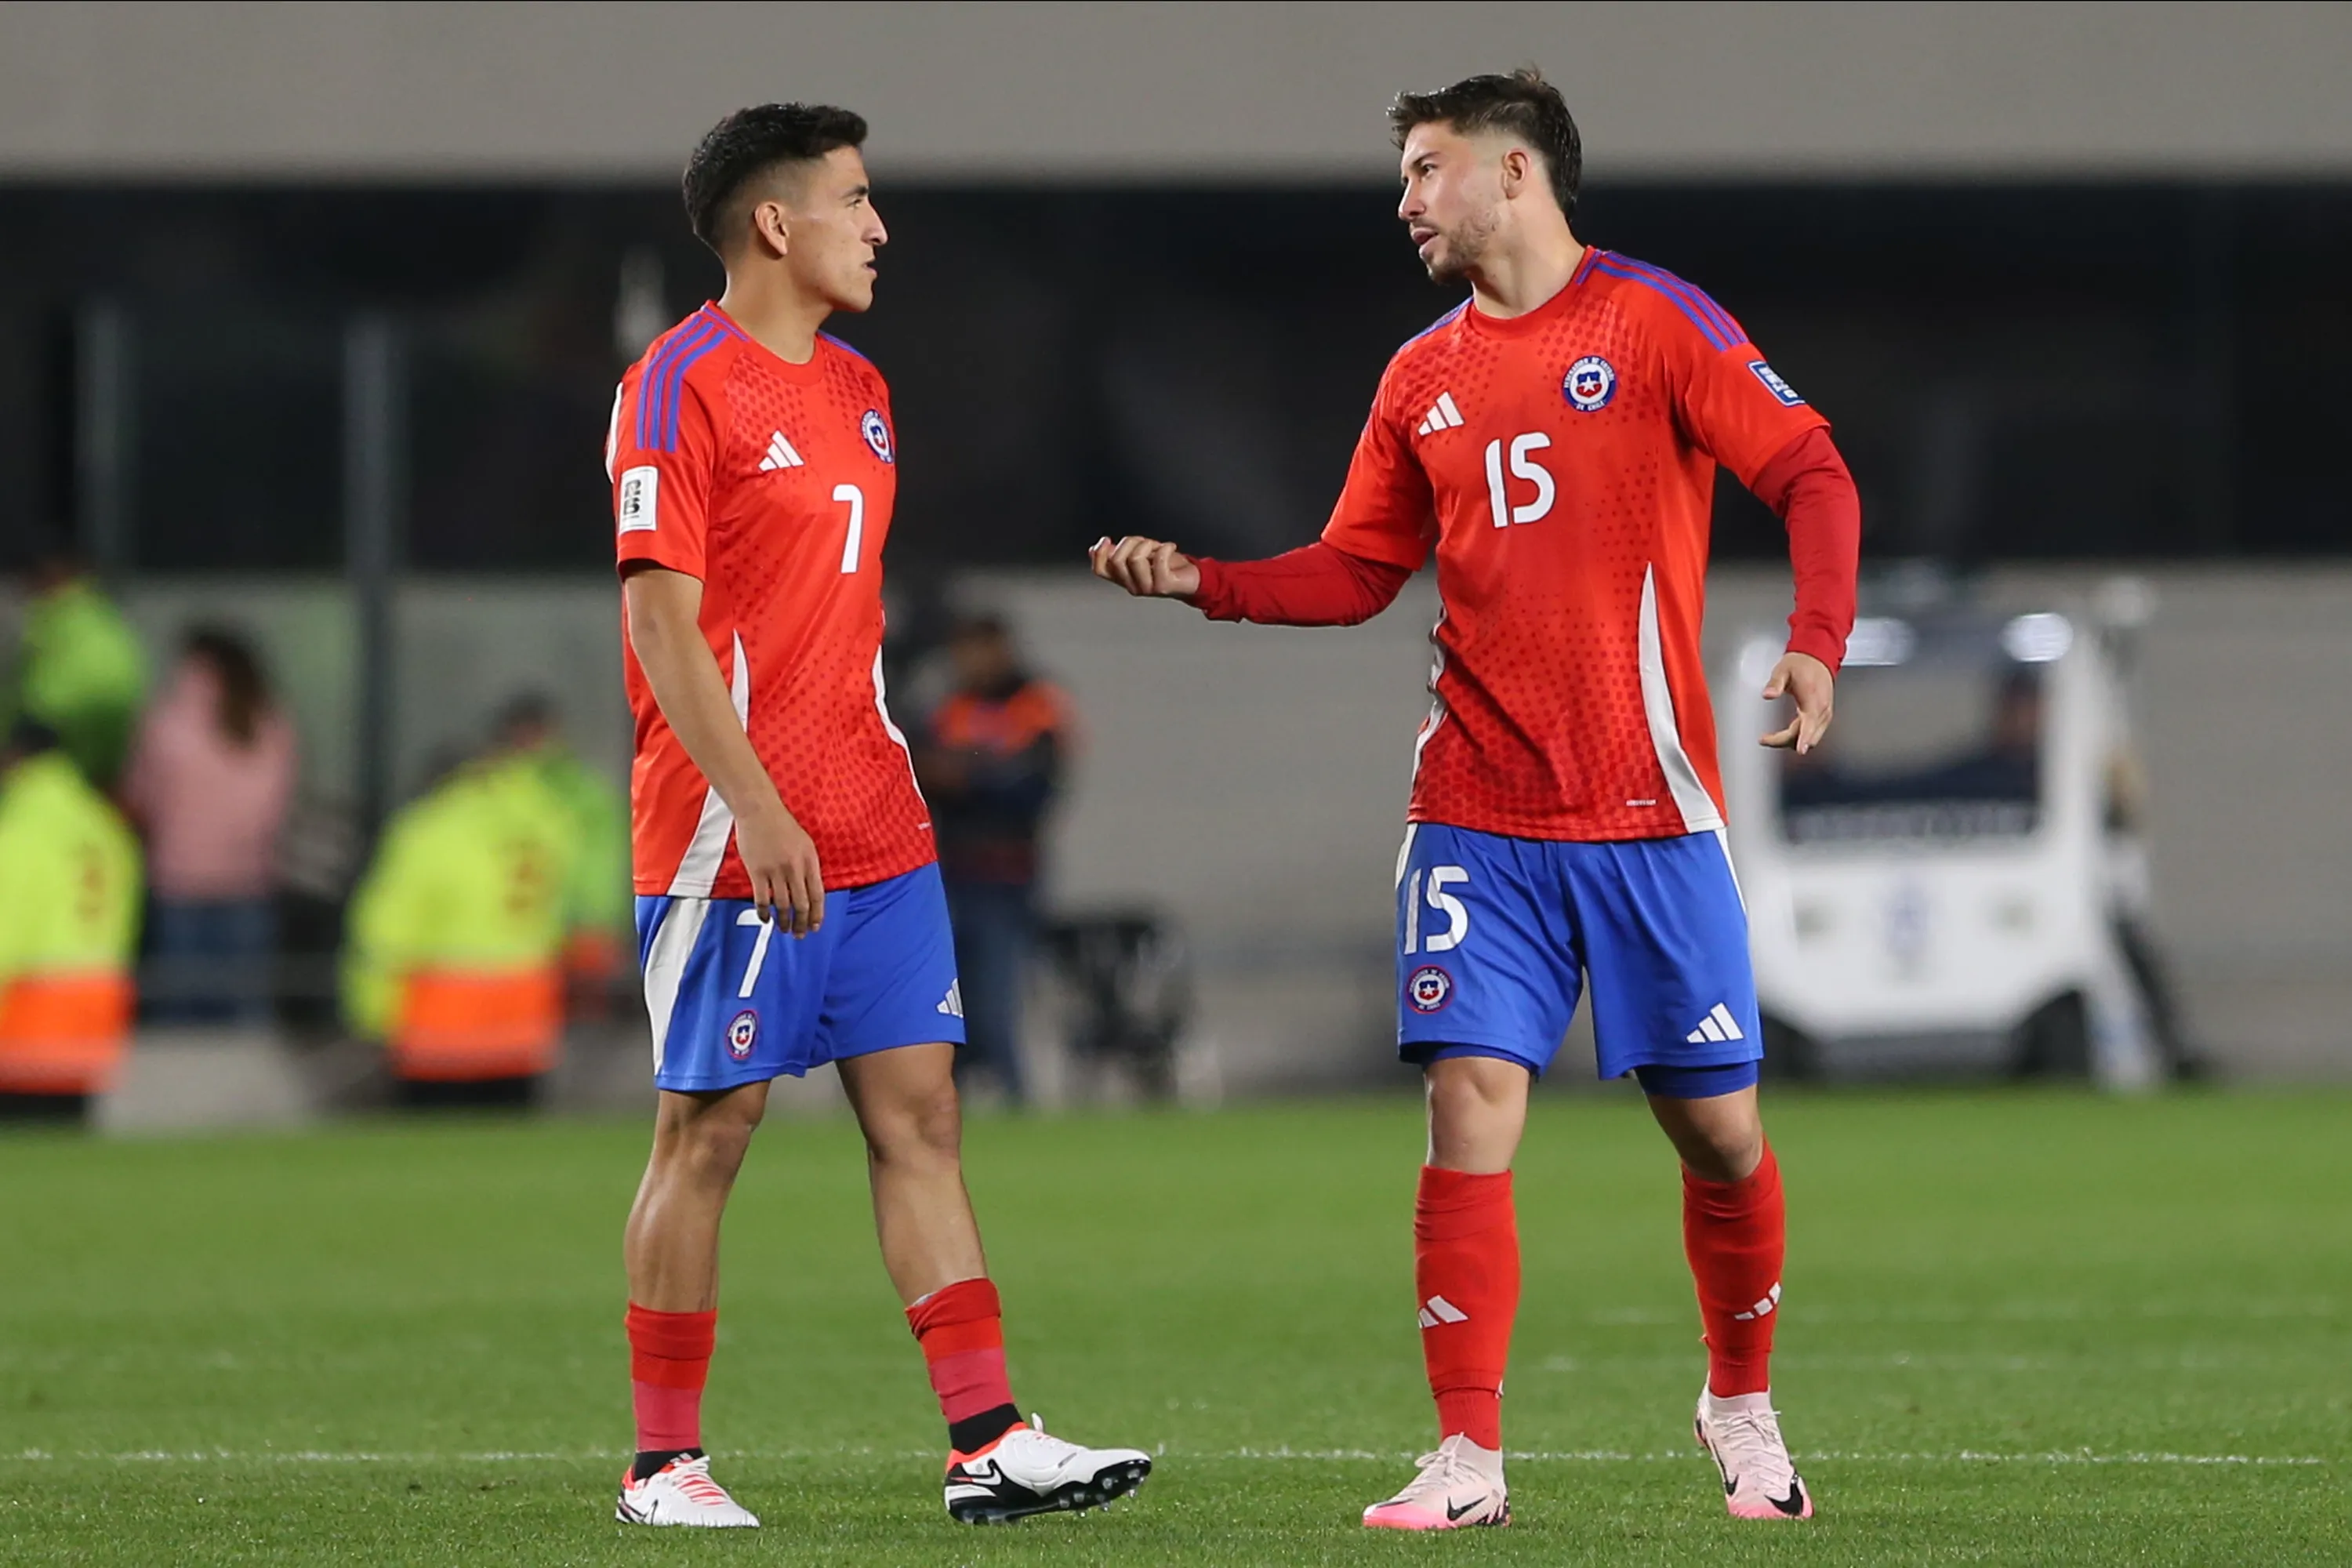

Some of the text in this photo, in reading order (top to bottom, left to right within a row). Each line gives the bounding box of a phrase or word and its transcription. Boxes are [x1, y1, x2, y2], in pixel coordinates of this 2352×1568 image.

[1484, 431, 1555, 529] 15
[832, 484, 863, 574] 7
[736, 908, 775, 998] 7
[1403, 865, 1469, 955] 15
